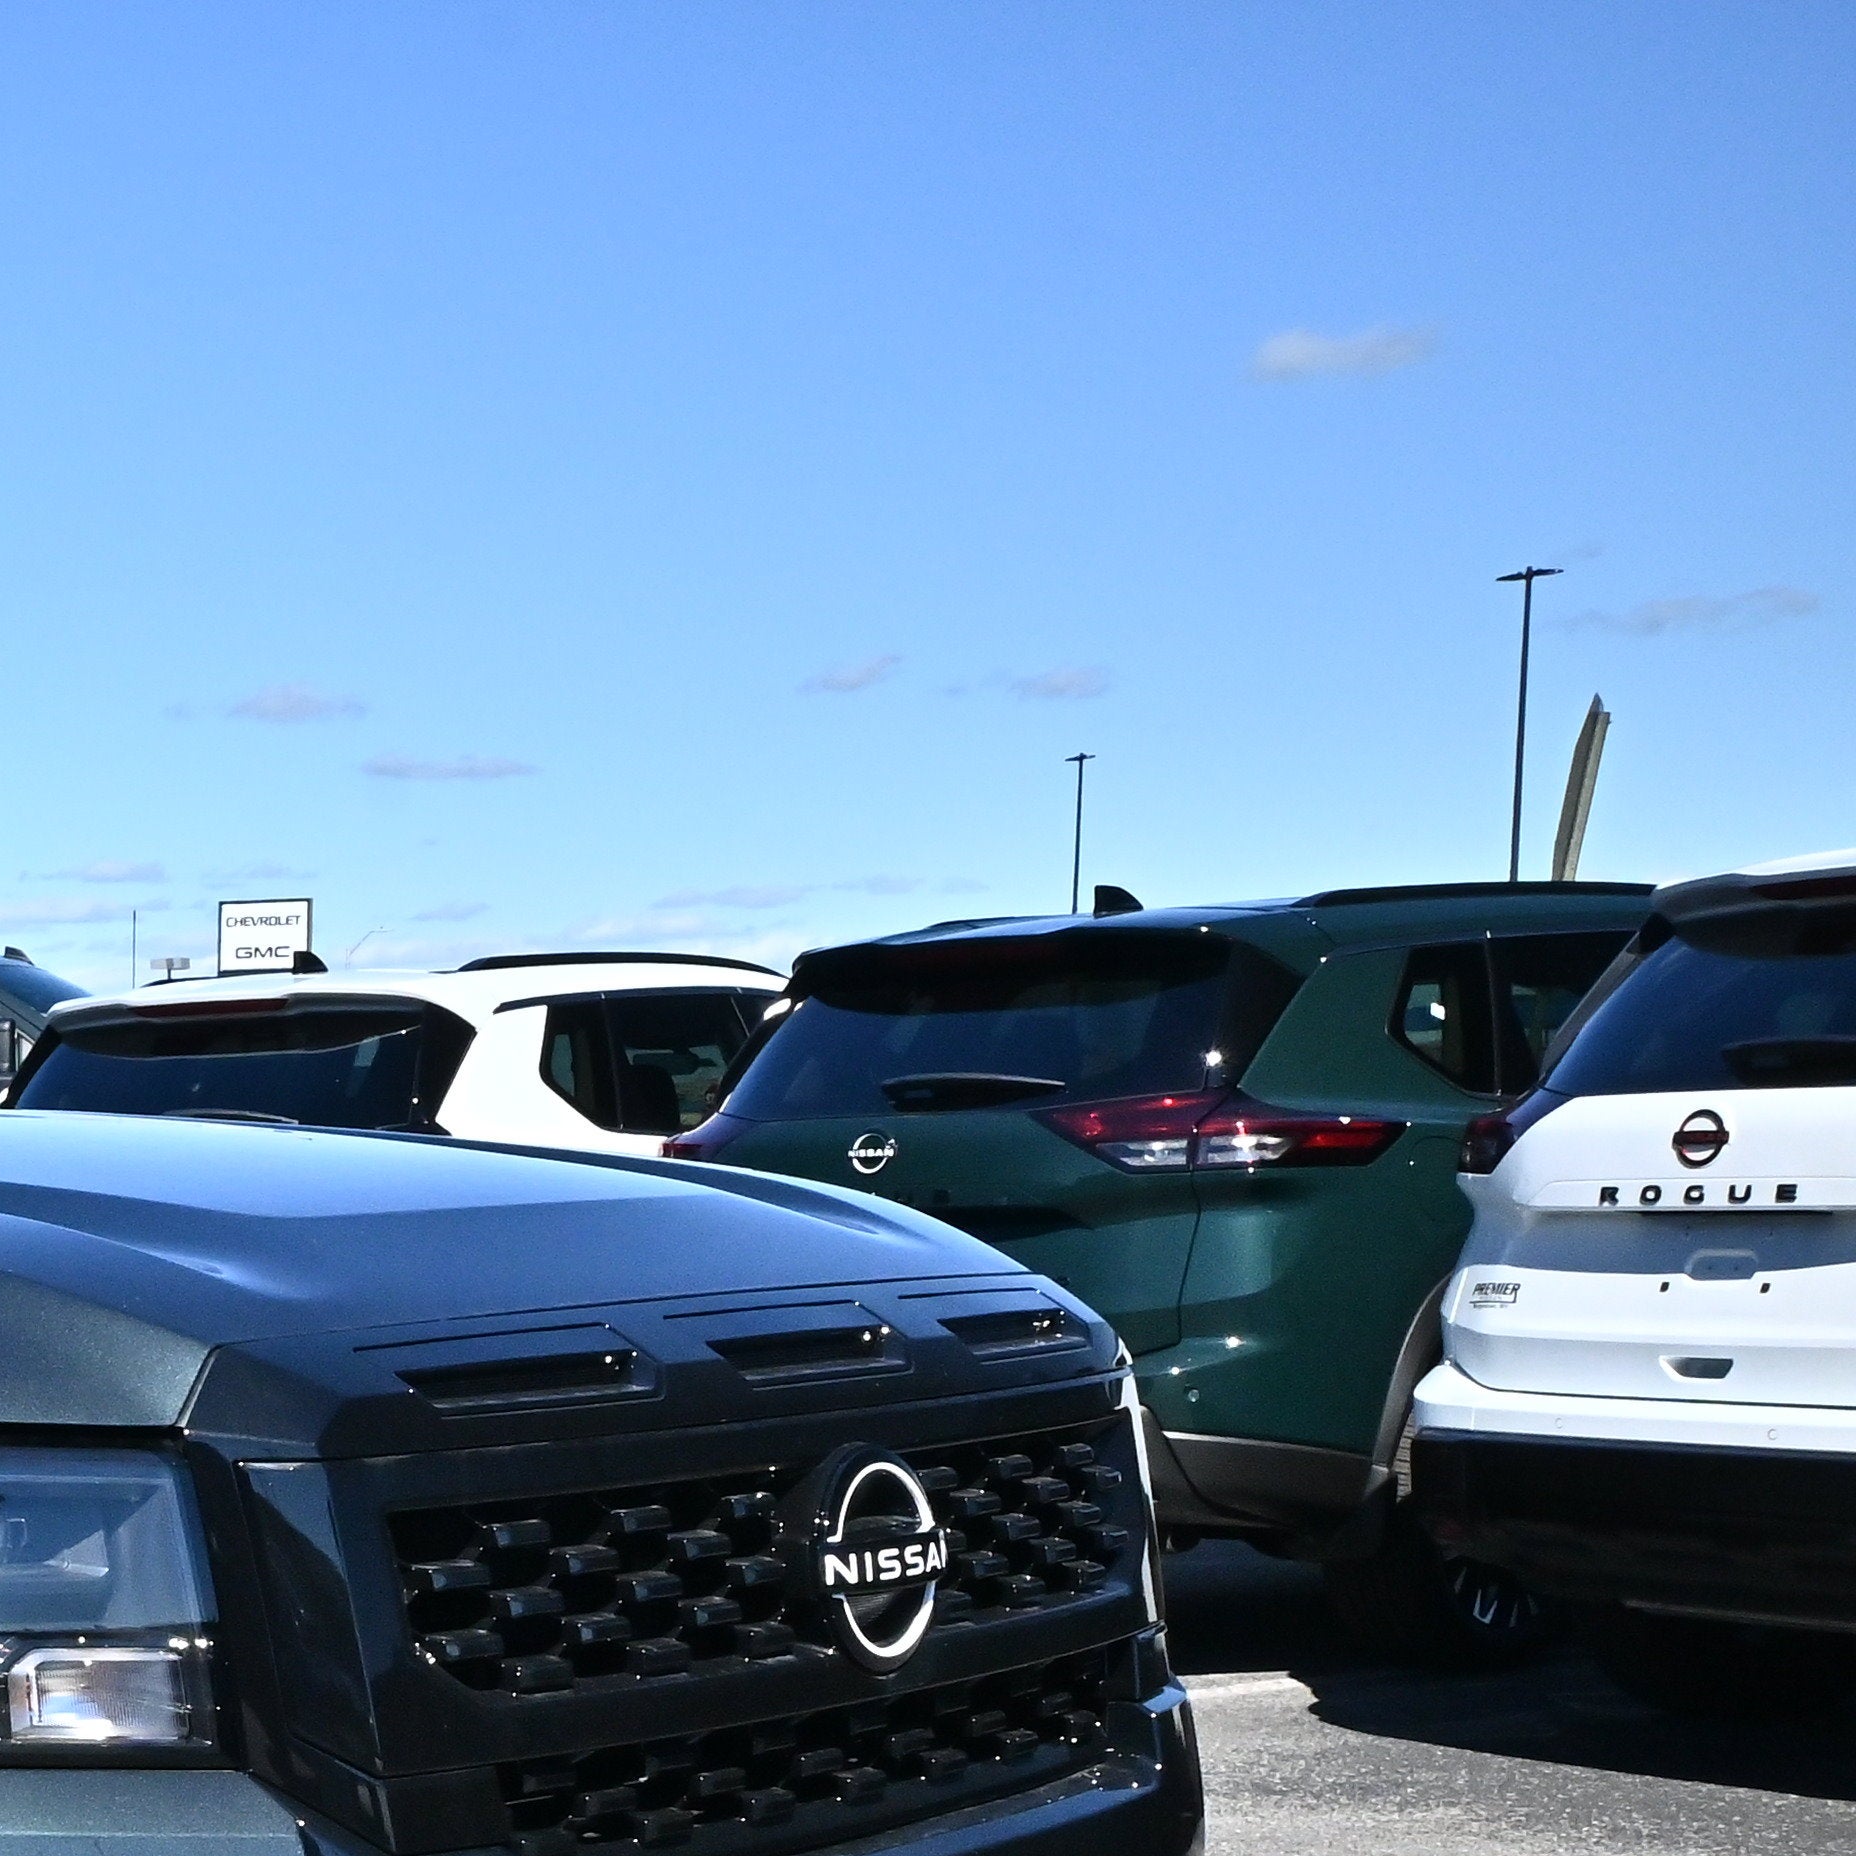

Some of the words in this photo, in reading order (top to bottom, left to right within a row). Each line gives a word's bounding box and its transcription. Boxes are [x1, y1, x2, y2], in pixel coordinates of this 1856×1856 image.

[225, 915, 301, 928] CHEVROLET
[235, 946, 290, 959] GMC
[848, 1149, 894, 1158] NISSAN
[1599, 1184, 1798, 1207] ROGUE
